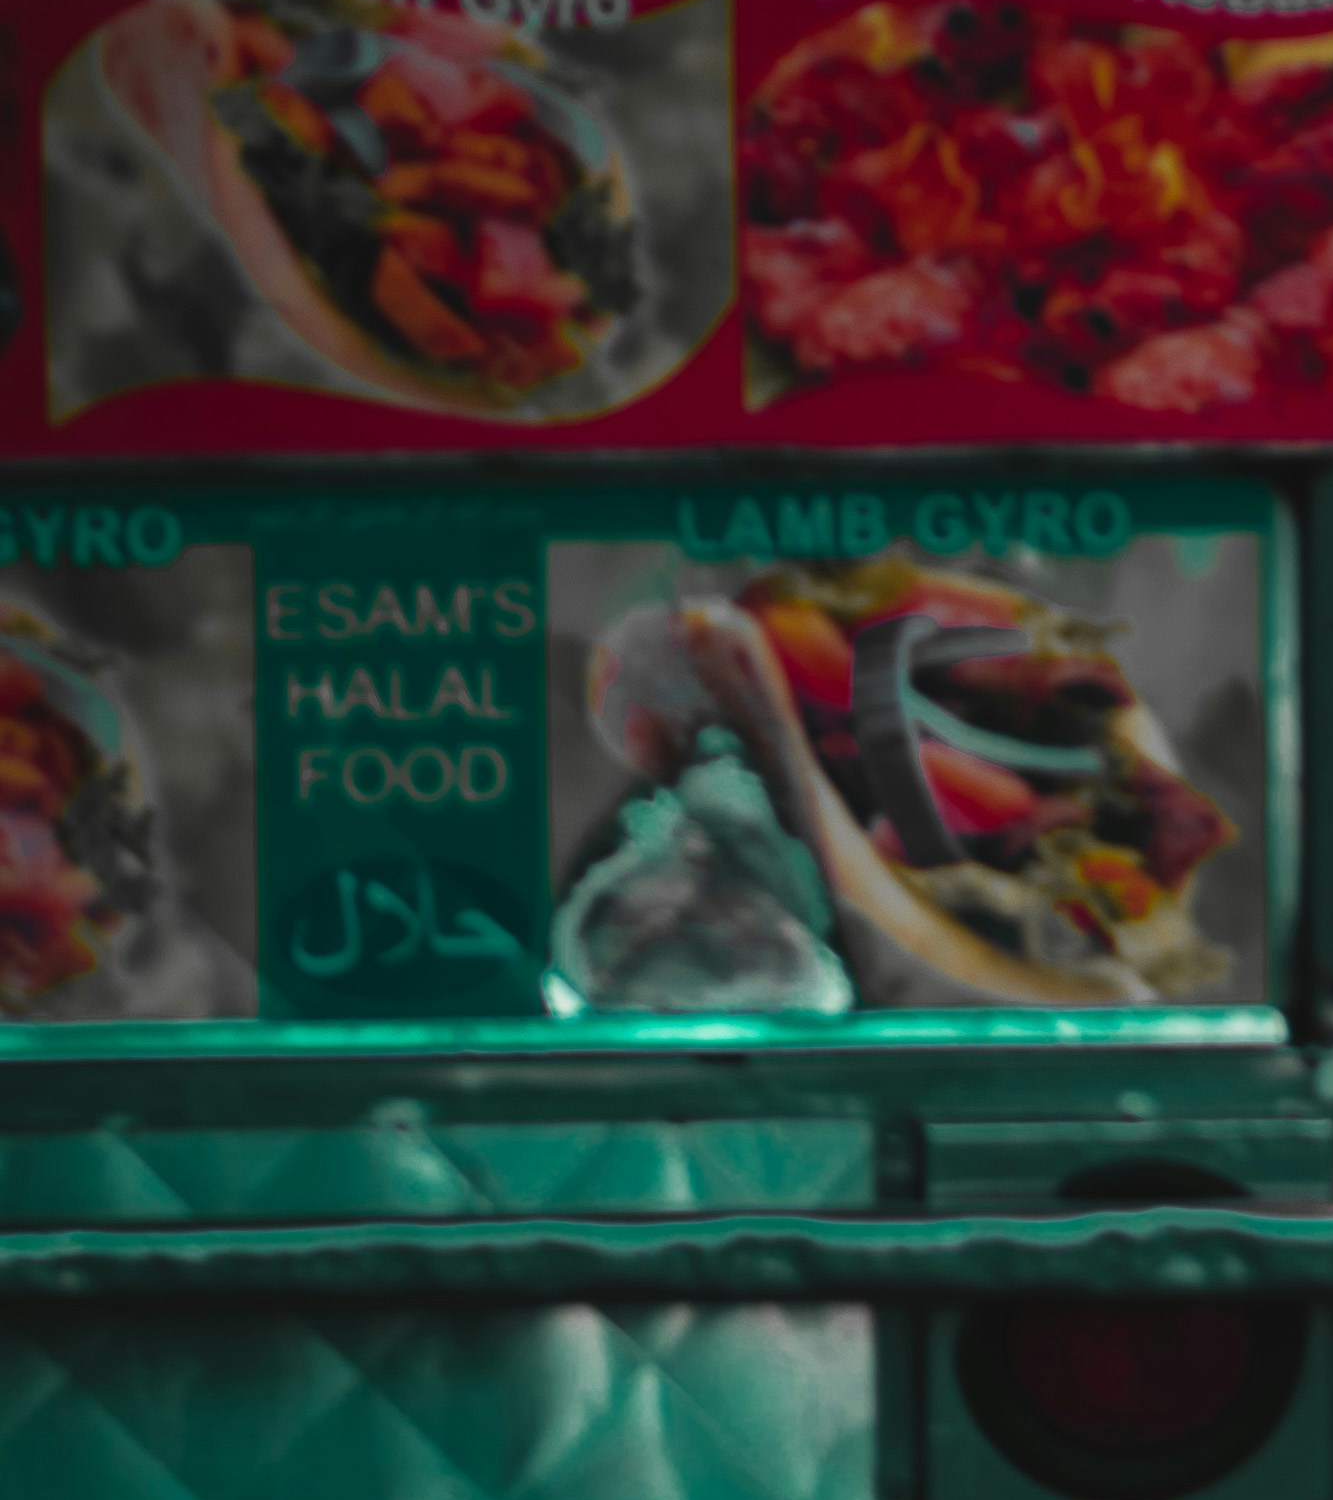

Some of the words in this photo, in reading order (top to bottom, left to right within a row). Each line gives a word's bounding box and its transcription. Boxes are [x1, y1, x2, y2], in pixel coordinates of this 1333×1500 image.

[676, 495, 884, 560] LAMB
[908, 490, 1132, 558] GYRO
[285, 665, 512, 720] HALAL
[297, 745, 508, 804] FOOD
